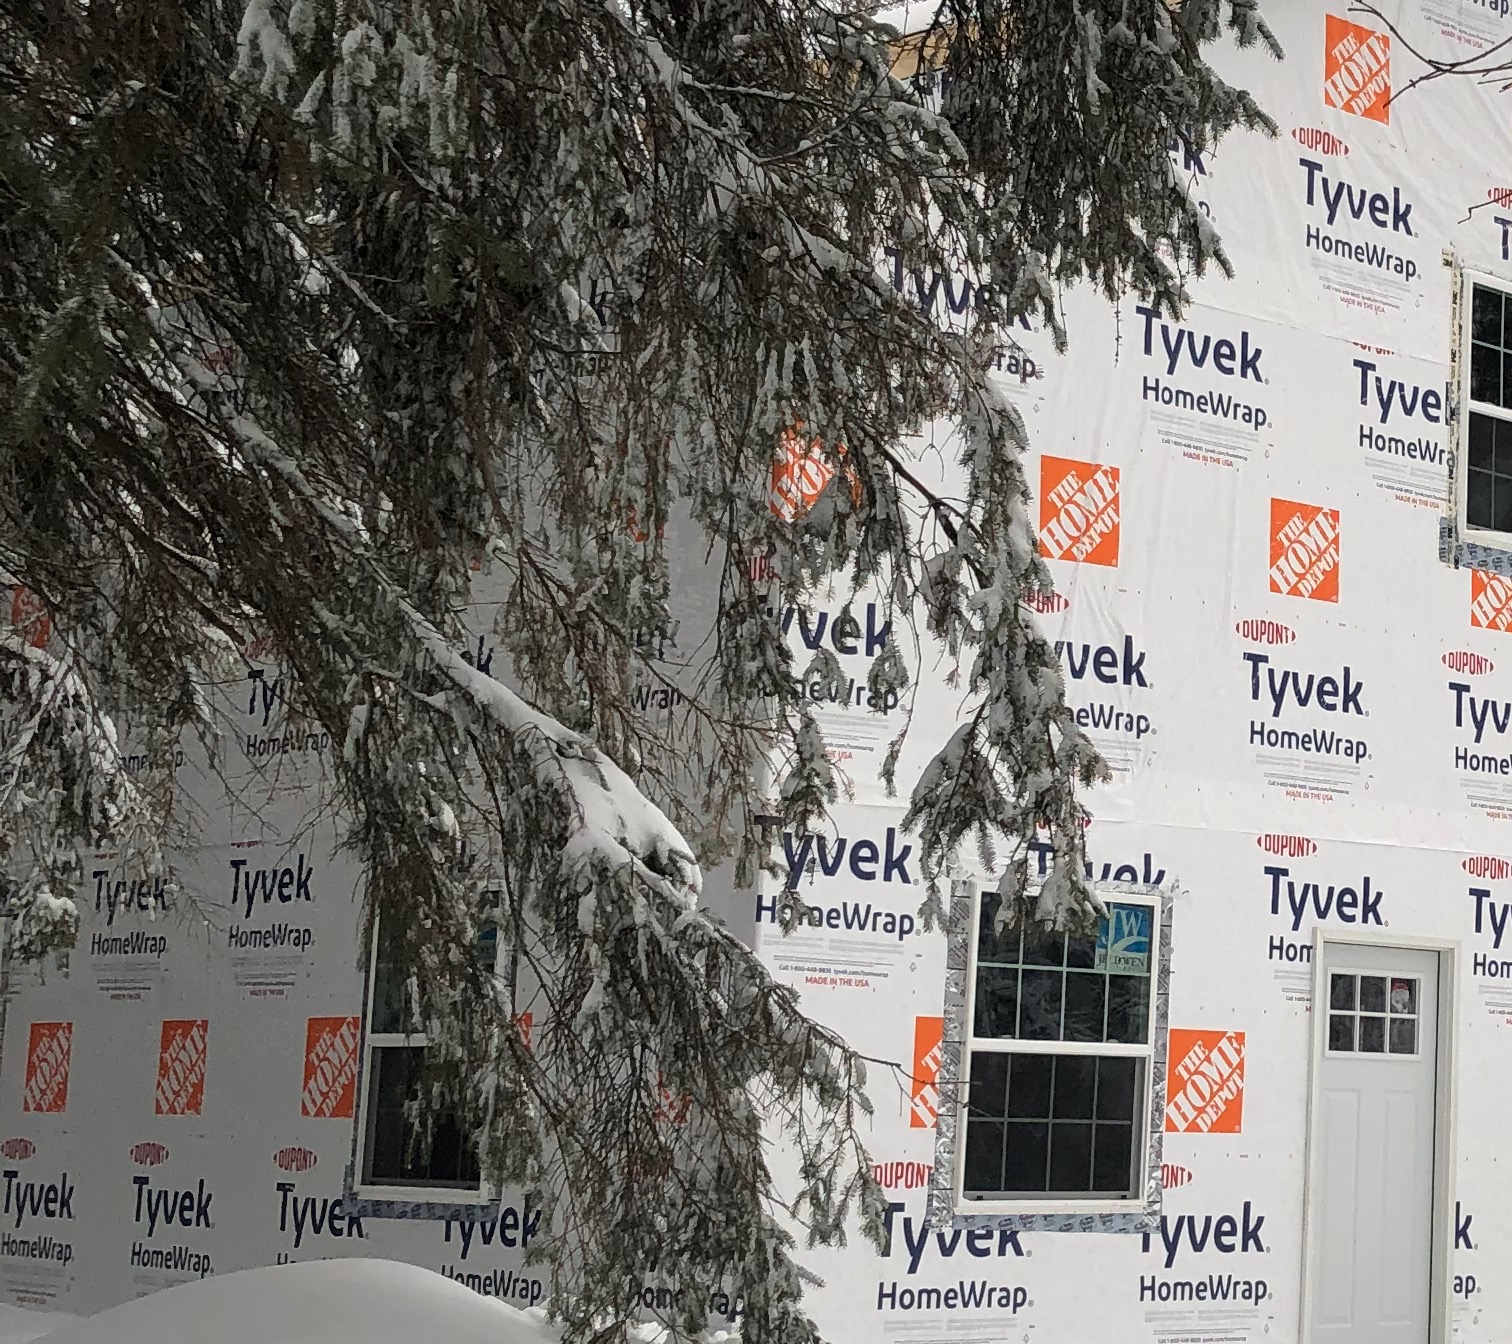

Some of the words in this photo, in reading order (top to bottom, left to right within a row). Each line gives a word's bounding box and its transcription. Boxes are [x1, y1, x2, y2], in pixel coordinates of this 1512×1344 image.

[1324, 31, 1391, 111] HOME
[1332, 31, 1359, 63] THE
[1349, 72, 1391, 123] DEPOT
[1299, 128, 1343, 155] DUPONT
[1300, 158, 1412, 238] Tyvek
[1307, 224, 1416, 281] HomeWrap
[1136, 305, 1262, 386] Tyvek
[1143, 376, 1266, 430] HomeWrap
[1358, 424, 1455, 469] HomeWra
[1038, 466, 1120, 560] HOME
[1047, 470, 1082, 508] THE
[1071, 504, 1120, 562] DEPOT
[1270, 508, 1340, 595] HOME
[1277, 513, 1307, 544] THE
[1298, 545, 1339, 599] DEPOT
[1243, 620, 1288, 644] DUPONT
[1055, 635, 1147, 687] vek
[1243, 652, 1363, 717] Tyvek
[1448, 652, 1488, 674] DUPONT
[1250, 721, 1367, 763] HomeWrap
[1264, 835, 1311, 856] DUPONT
[1468, 857, 1510, 879] DUPONT
[229, 853, 315, 920] Tyvek
[1264, 866, 1383, 931] Tyvek
[91, 932, 166, 958] HomeWrap
[229, 924, 311, 952] HomeWrap
[805, 976, 828, 985] MADE
[829, 977, 837, 985] IN
[840, 978, 853, 987] THE
[855, 979, 870, 987] USA
[1166, 1031, 1246, 1133] HOME
[1174, 1040, 1207, 1083] THE
[1195, 1070, 1245, 1133] DEPOT
[3, 1170, 74, 1228] Tyvek
[1161, 1164, 1185, 1188] ONT
[133, 1176, 212, 1237] Tyvek
[276, 1182, 365, 1249] Tyvek
[1, 1233, 72, 1266] HomeWrap
[131, 1242, 210, 1279] HomeWrap
[878, 1281, 1026, 1314] HomeWrap
[1140, 1275, 1267, 1306] HomeWrap
